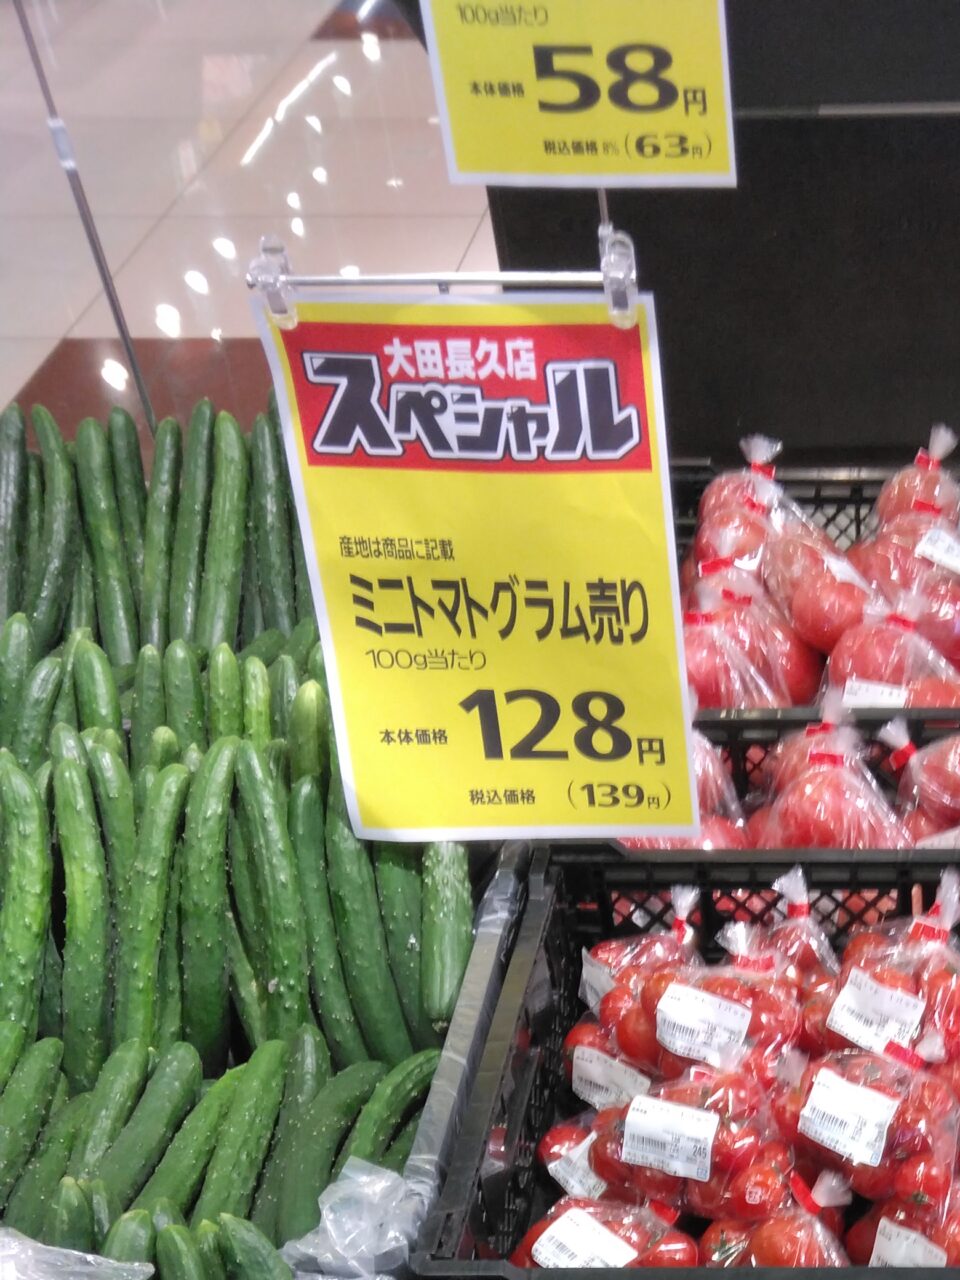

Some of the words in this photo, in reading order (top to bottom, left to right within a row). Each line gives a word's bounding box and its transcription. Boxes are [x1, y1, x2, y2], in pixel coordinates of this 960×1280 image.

[458, 3, 550, 26] 100g当たり
[469, 82, 525, 98] 本体価格
[543, 140, 598, 156] 税込価格
[383, 338, 537, 381] 大田長久店
[302, 350, 643, 459] スペシャル
[339, 536, 455, 561] 産地は商品に記載
[349, 573, 650, 646] ミニトマトグラム売り
[365, 649, 487, 671] 100g当たり
[379, 729, 449, 746] 本体価格
[469, 789, 536, 805] 税込価格
